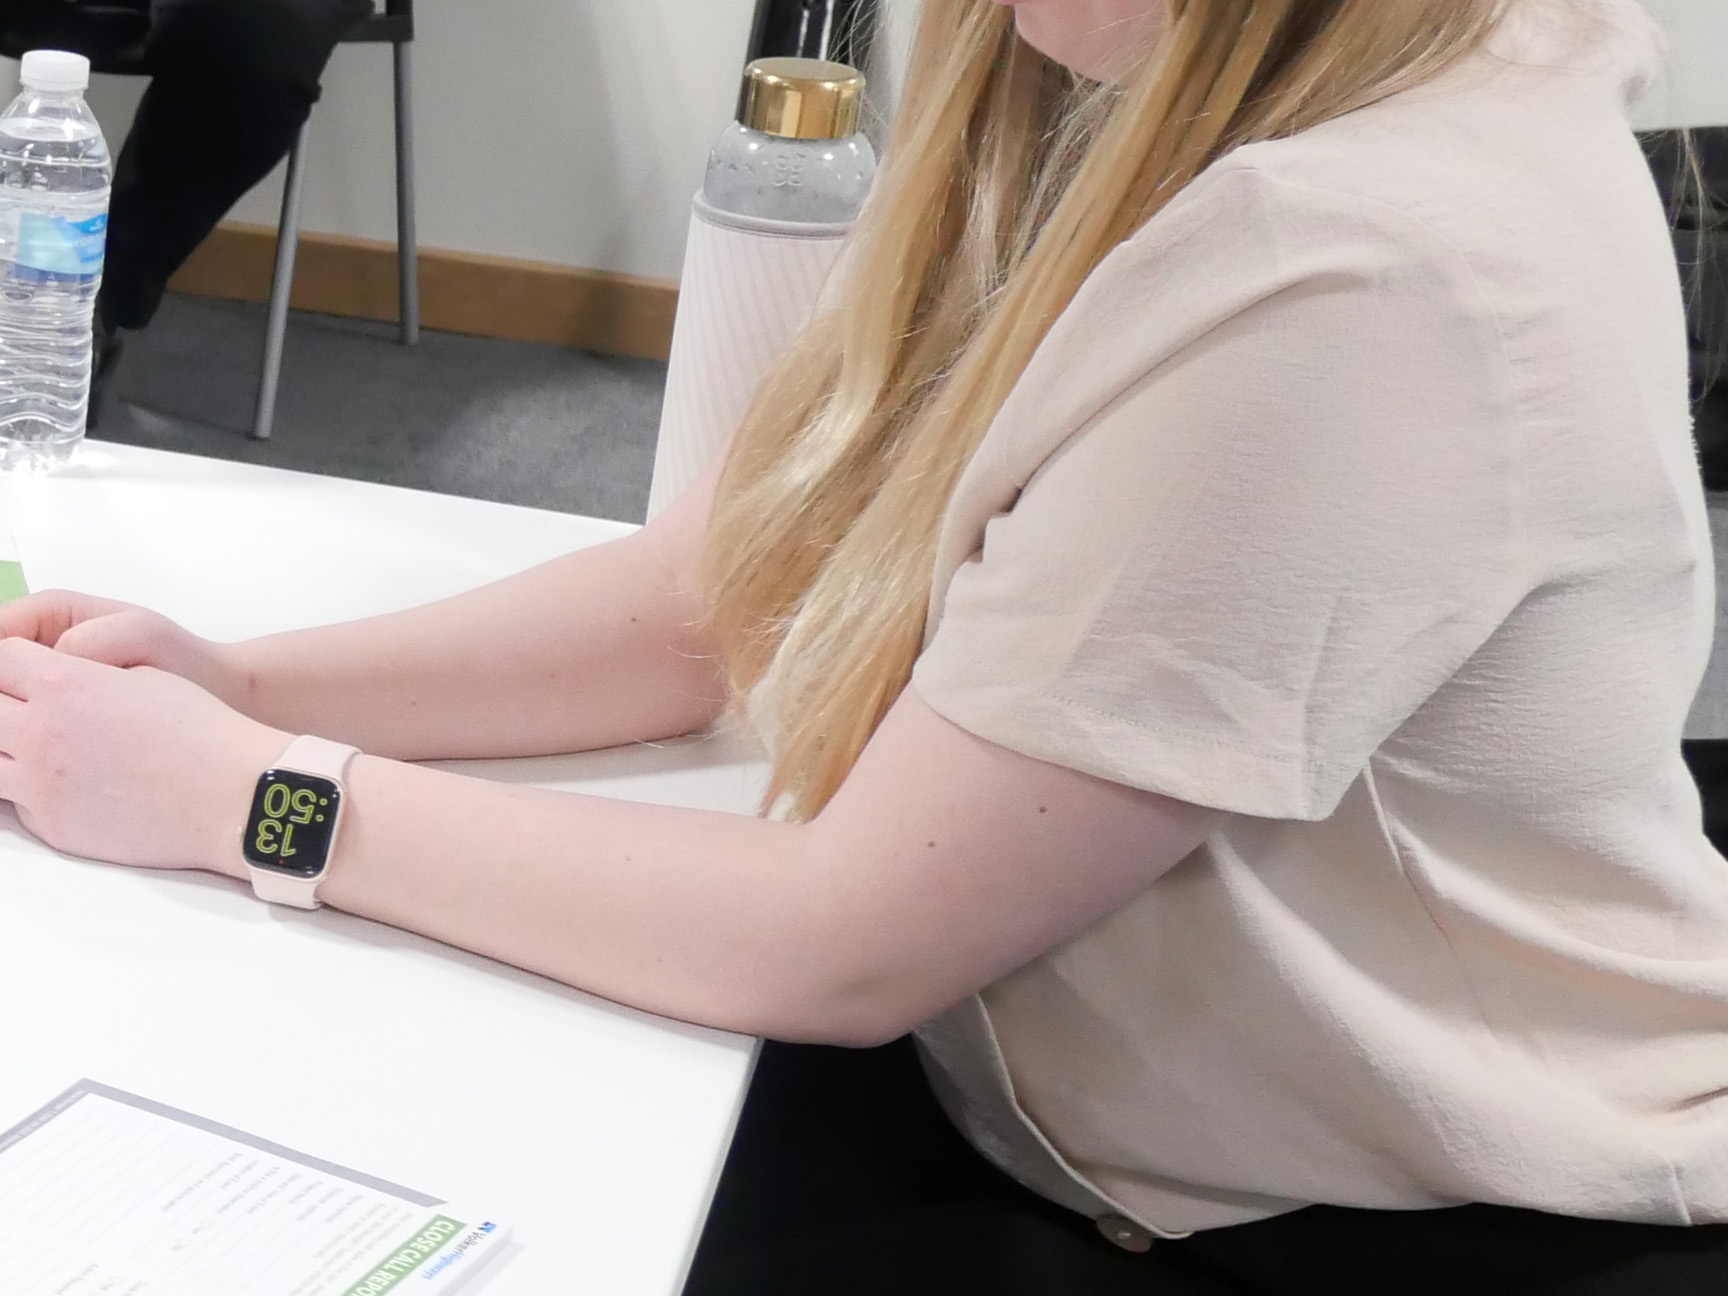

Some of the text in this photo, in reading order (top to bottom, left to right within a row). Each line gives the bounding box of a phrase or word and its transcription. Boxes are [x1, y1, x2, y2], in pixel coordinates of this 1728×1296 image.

[255, 818, 297, 857] 13
[407, 1218, 457, 1253] CLOSE
[380, 1246, 424, 1275] CALL
[417, 1229, 488, 1282] VolkerHighways
